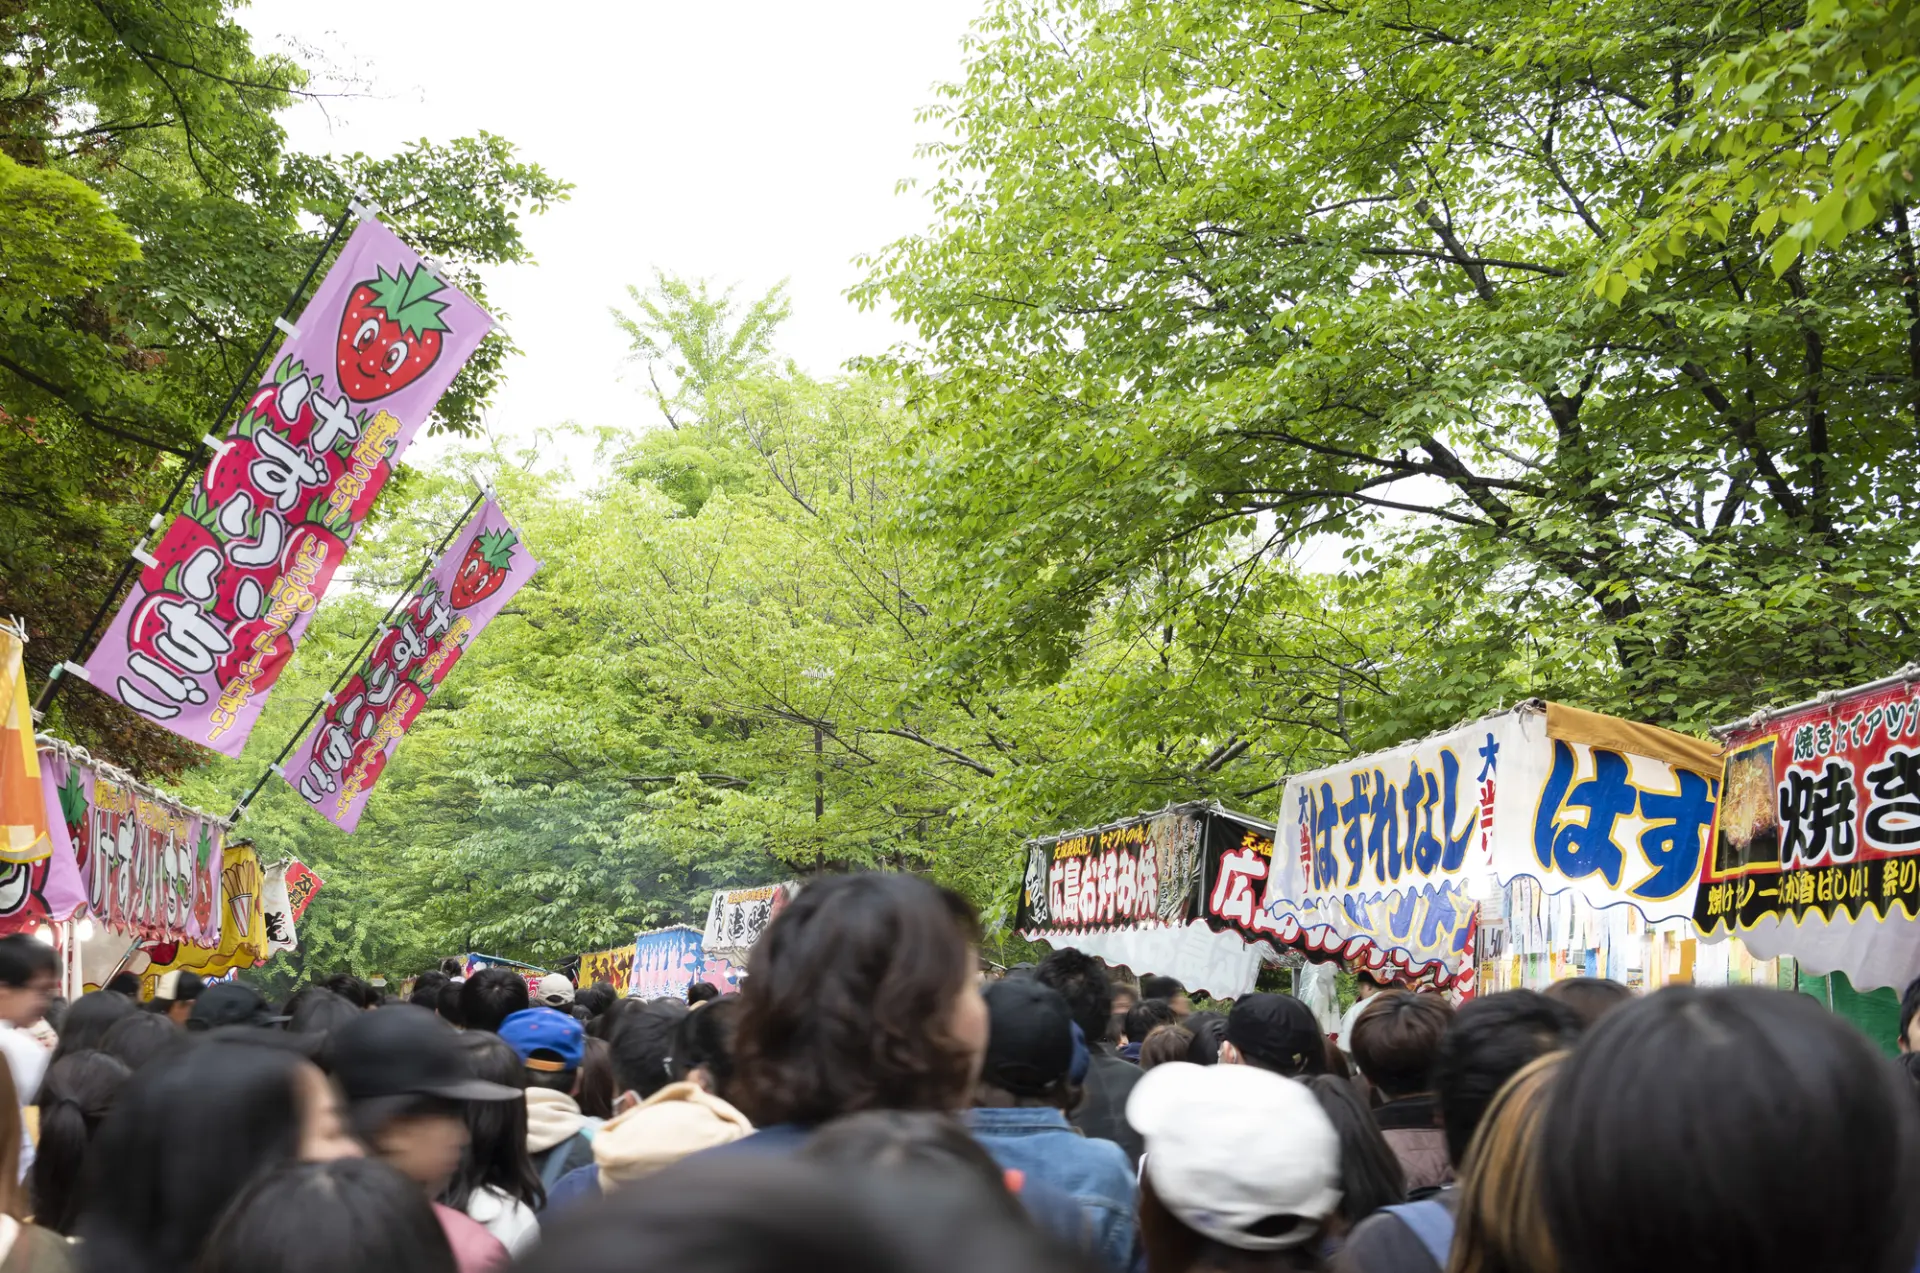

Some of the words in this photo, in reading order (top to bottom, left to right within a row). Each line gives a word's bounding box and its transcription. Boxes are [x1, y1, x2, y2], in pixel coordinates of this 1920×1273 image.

[323, 409, 405, 523] 練乳たっぷり!
[116, 371, 359, 719] けずりいちご
[301, 589, 452, 804] けずりいちご
[1310, 746, 1480, 891] はずれなし
[1883, 859, 1920, 897] 祭り
